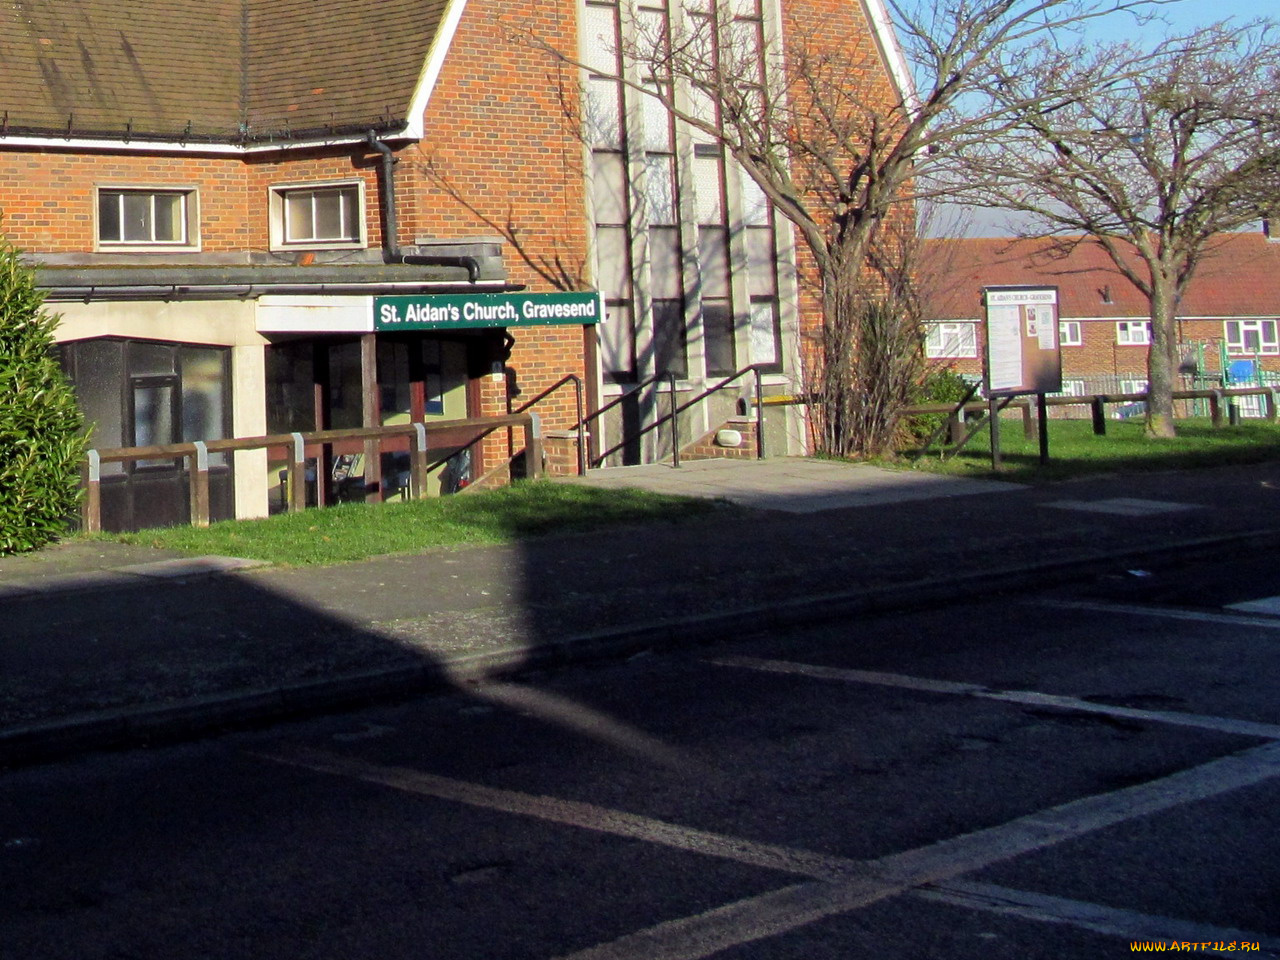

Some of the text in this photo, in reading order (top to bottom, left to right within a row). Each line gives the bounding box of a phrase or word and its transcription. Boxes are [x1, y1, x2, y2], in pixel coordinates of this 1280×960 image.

[380, 300, 595, 323] St. Aidan's Church, Gravesend
